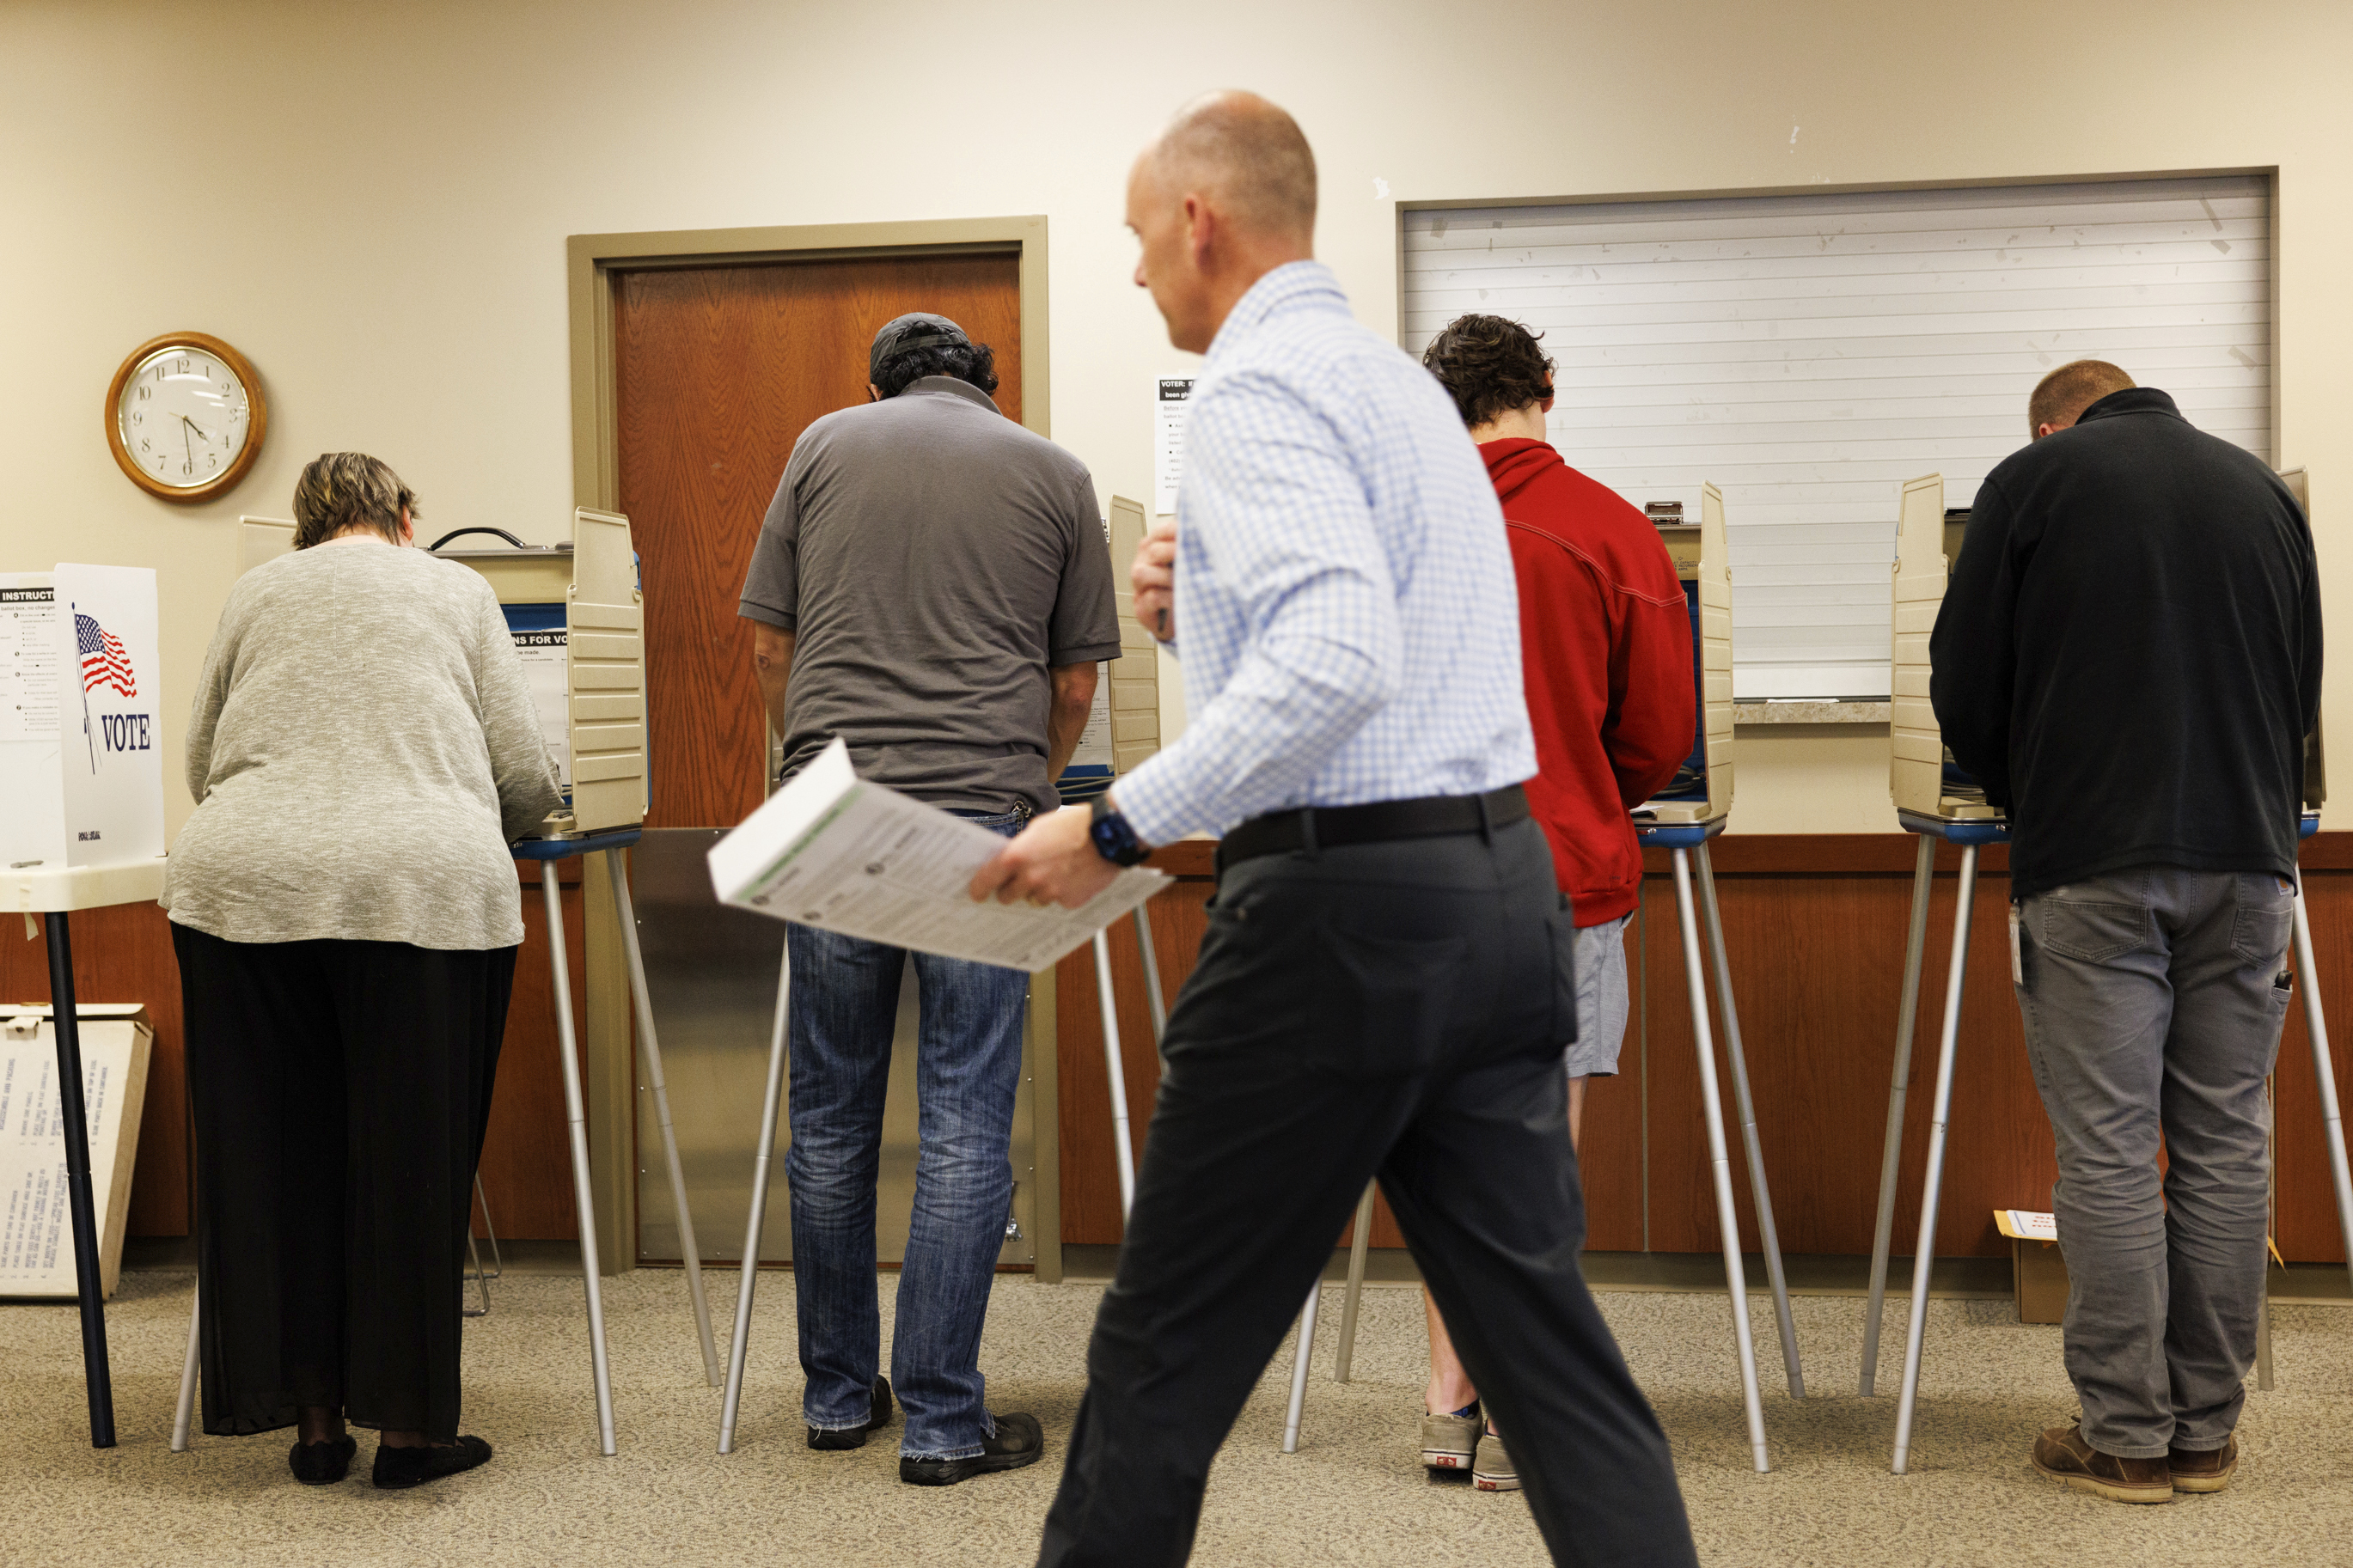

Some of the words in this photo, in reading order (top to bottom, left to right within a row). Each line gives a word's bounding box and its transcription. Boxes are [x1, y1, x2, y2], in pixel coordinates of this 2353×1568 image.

[156, 367, 165, 381] 11
[177, 359, 189, 374] 12
[206, 365, 210, 378] 1
[139, 385, 151, 400] 10
[222, 382, 230, 397] 2
[133, 412, 143, 426] 9
[229, 408, 237, 424] 3
[142, 436, 150, 453] 8
[222, 435, 229, 448] 4
[158, 455, 167, 470] 7
[182, 460, 193, 475] 6
[208, 453, 217, 468] 5
[529, 636, 552, 644] FOR
[101, 714, 150, 752] VOTE
